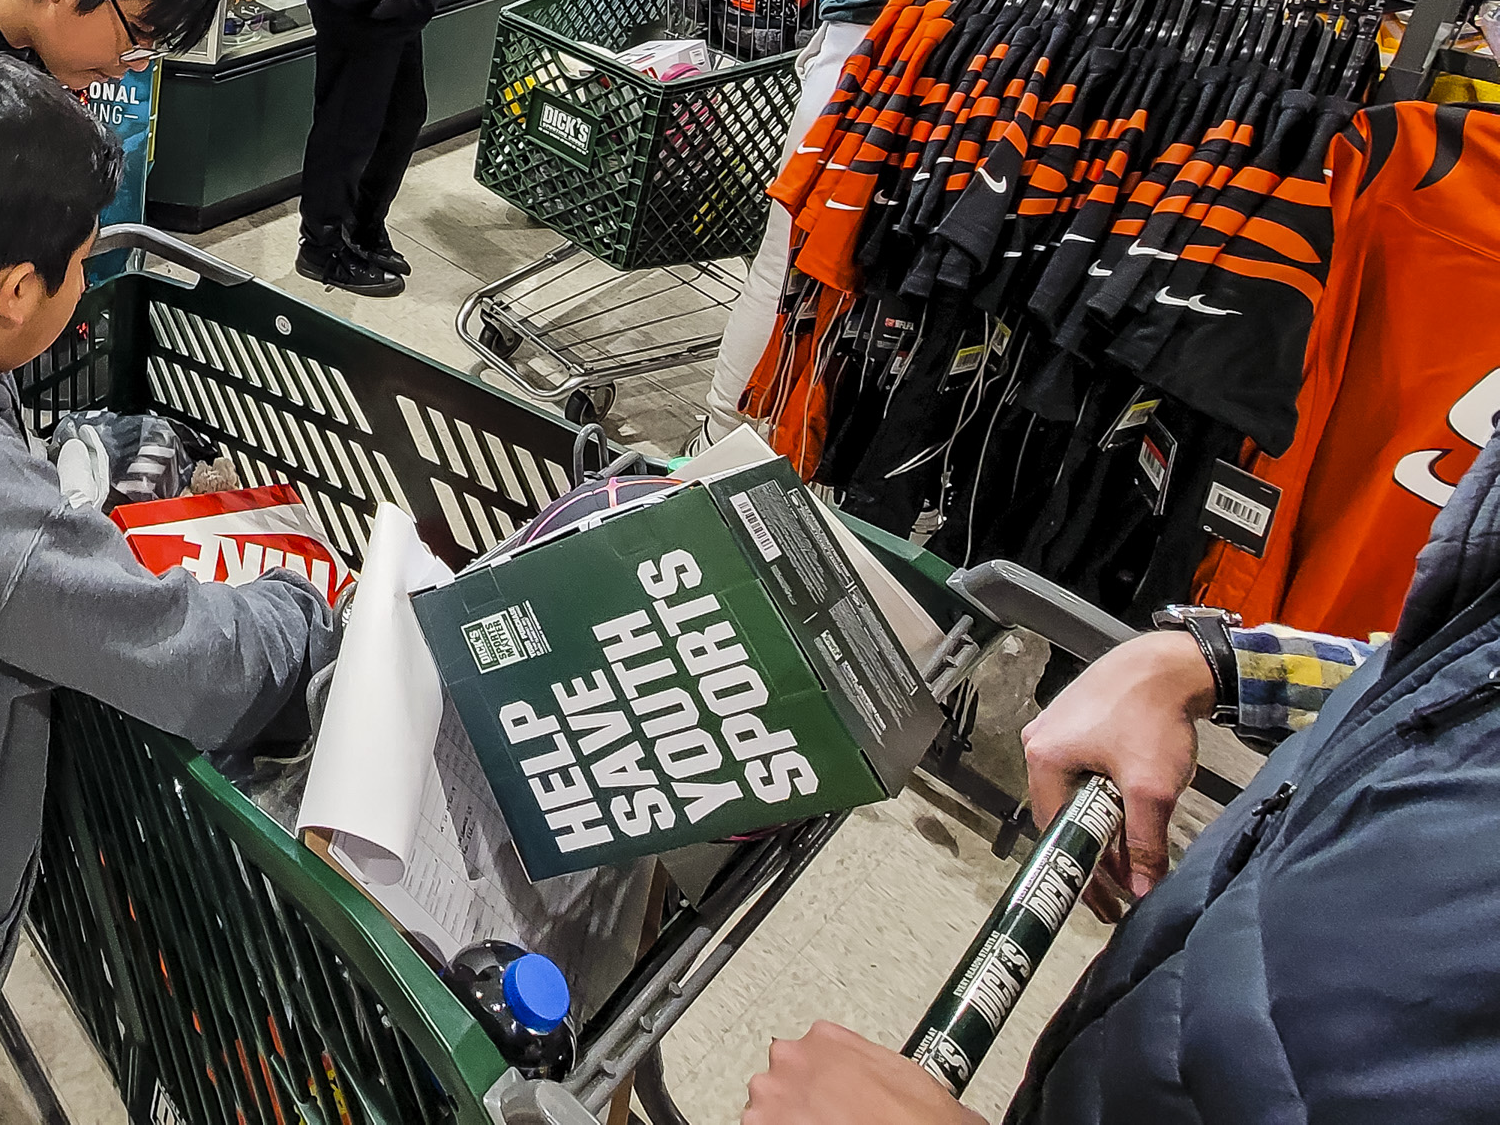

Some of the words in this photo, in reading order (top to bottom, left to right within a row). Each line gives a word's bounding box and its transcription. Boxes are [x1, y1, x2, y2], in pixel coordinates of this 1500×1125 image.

[543, 105, 588, 142] DICK'S
[469, 630, 491, 664] DICK'S
[485, 623, 507, 660] SPORTS
[493, 620, 515, 657] MATTER
[637, 549, 819, 804] SPORTS
[592, 610, 744, 824] YOUTH
[499, 700, 615, 853] HELP
[551, 669, 676, 837] SAVE
[1028, 855, 1084, 930] DICK'S
[953, 975, 970, 996] EVERY
[964, 954, 984, 978] SEASON
[977, 935, 996, 958] STARTS
[989, 930, 1000, 940] AT
[969, 942, 1031, 1027] DICK'S
[914, 1032, 933, 1059] STARTS
[929, 1027, 938, 1037] AT
